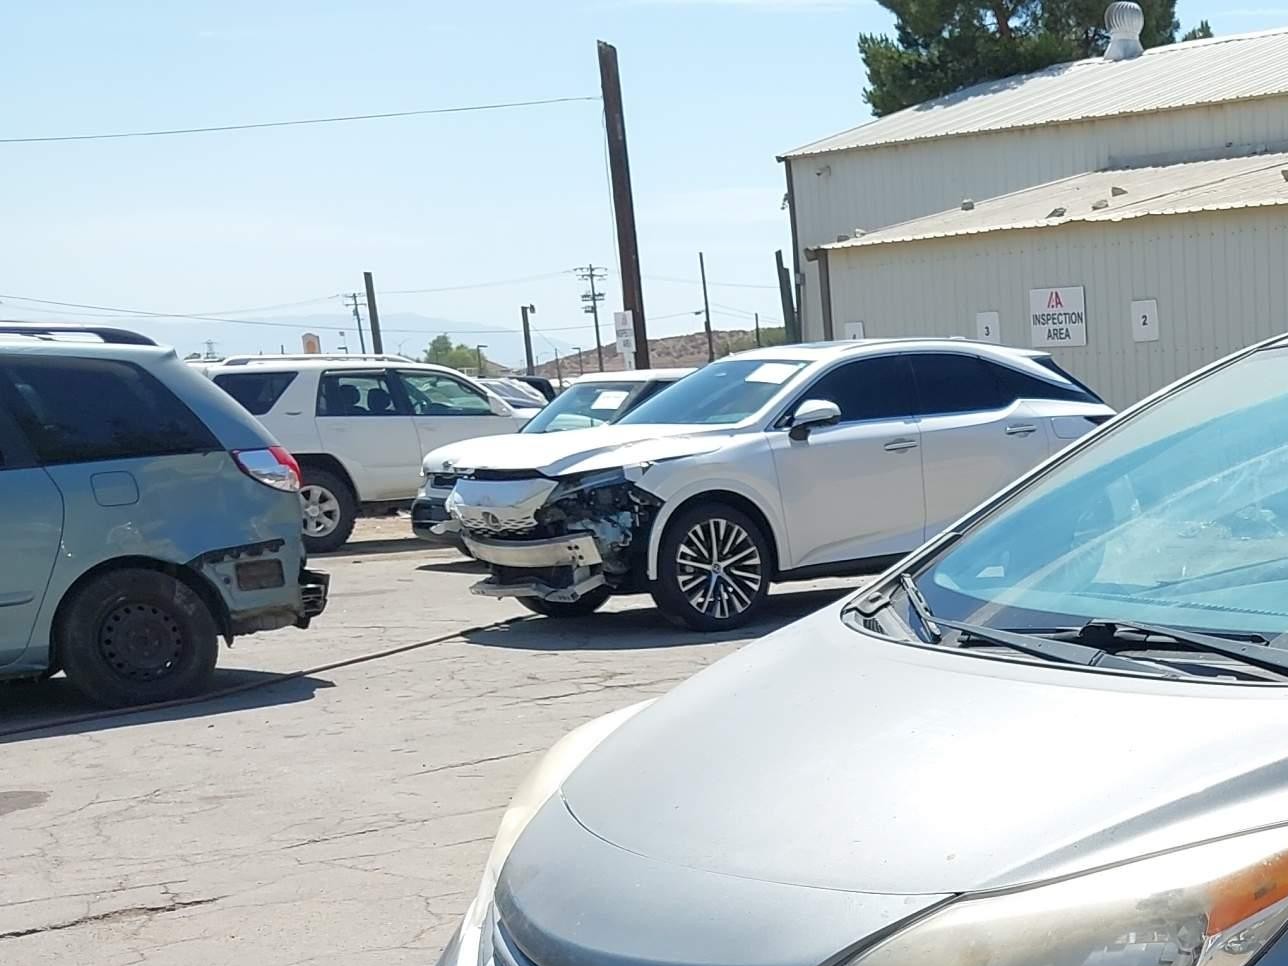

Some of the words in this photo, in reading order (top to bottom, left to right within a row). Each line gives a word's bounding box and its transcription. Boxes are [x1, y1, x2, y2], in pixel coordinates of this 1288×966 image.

[1032, 311, 1084, 326] INSPECTION
[1141, 314, 1149, 327] 2
[984, 326, 991, 337] 3
[1046, 327, 1072, 341] AREA
